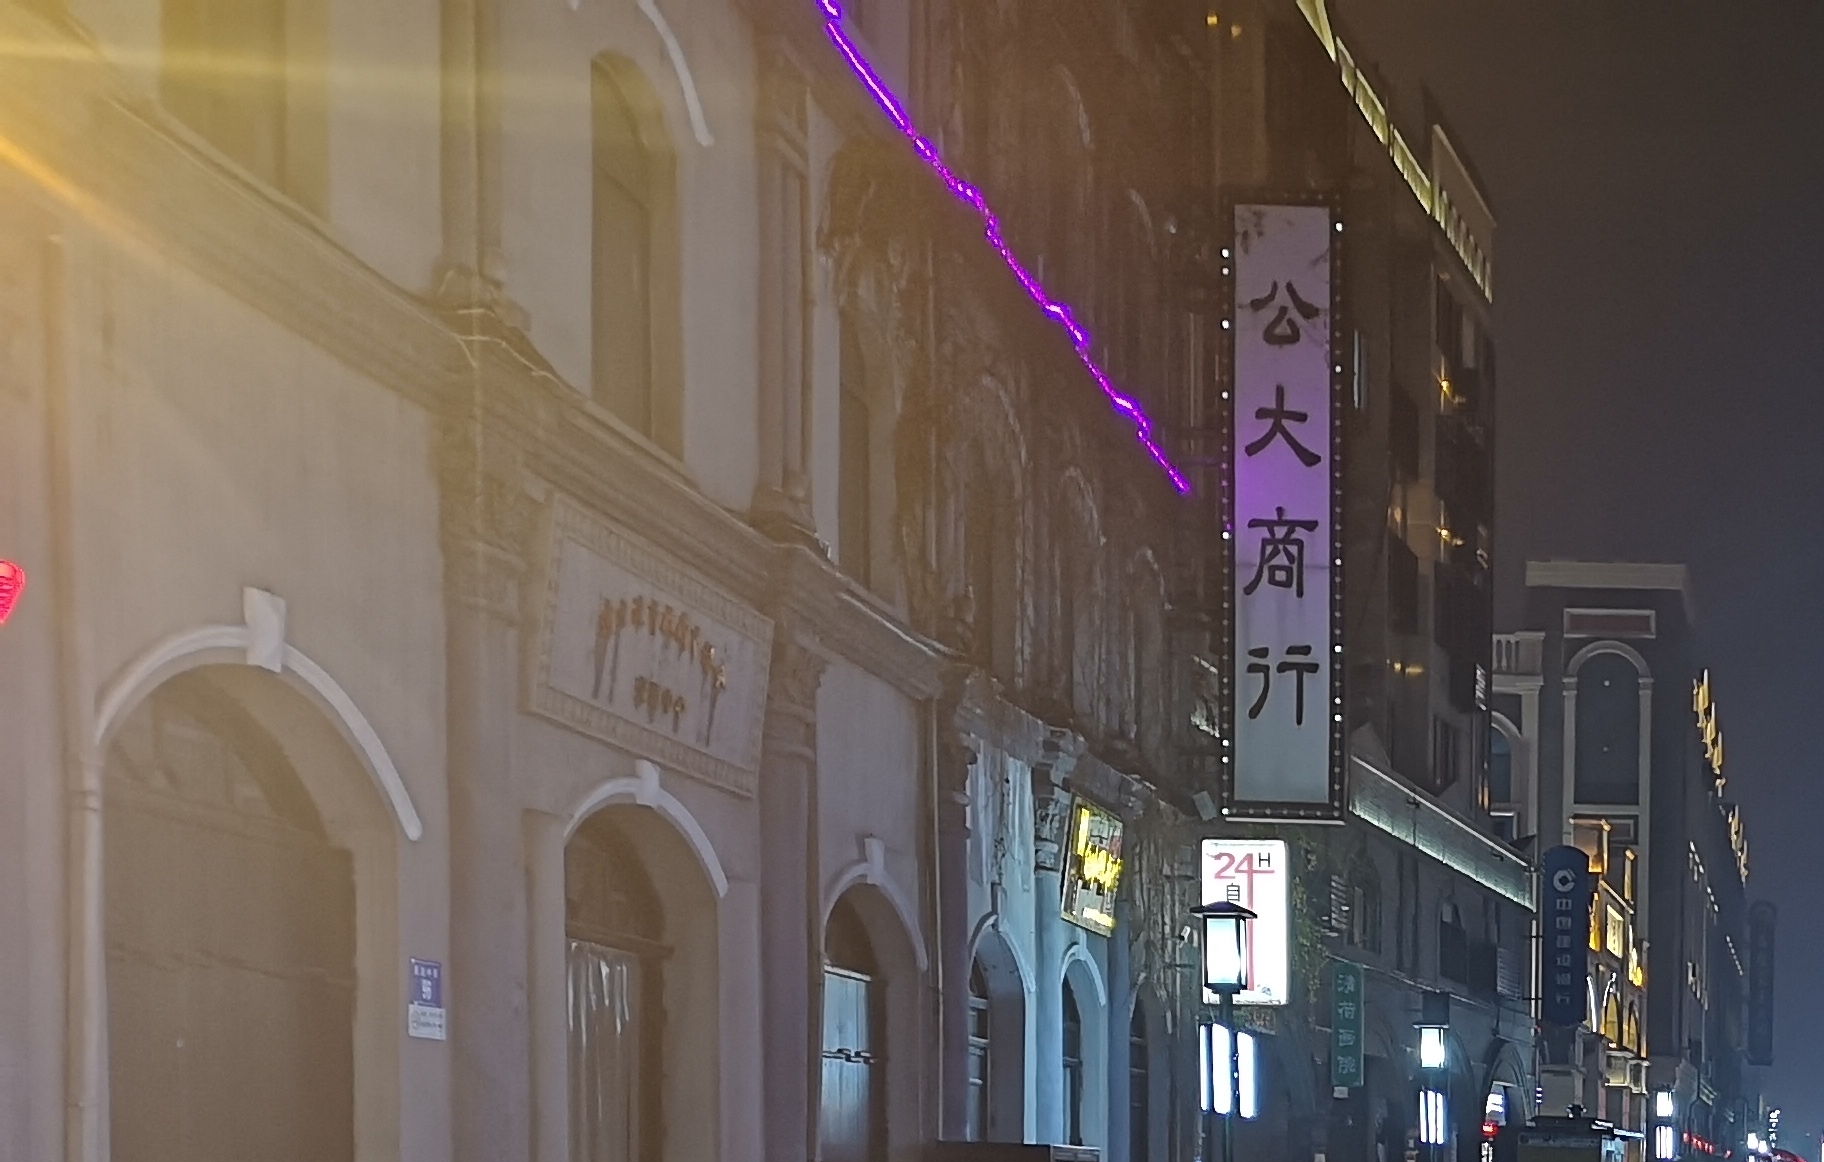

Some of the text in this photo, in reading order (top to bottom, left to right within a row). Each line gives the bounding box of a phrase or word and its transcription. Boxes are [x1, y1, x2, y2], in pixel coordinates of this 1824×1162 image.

[1244, 281, 1323, 728] 公大商行
[1555, 897, 1572, 1005] 中国建设银行
